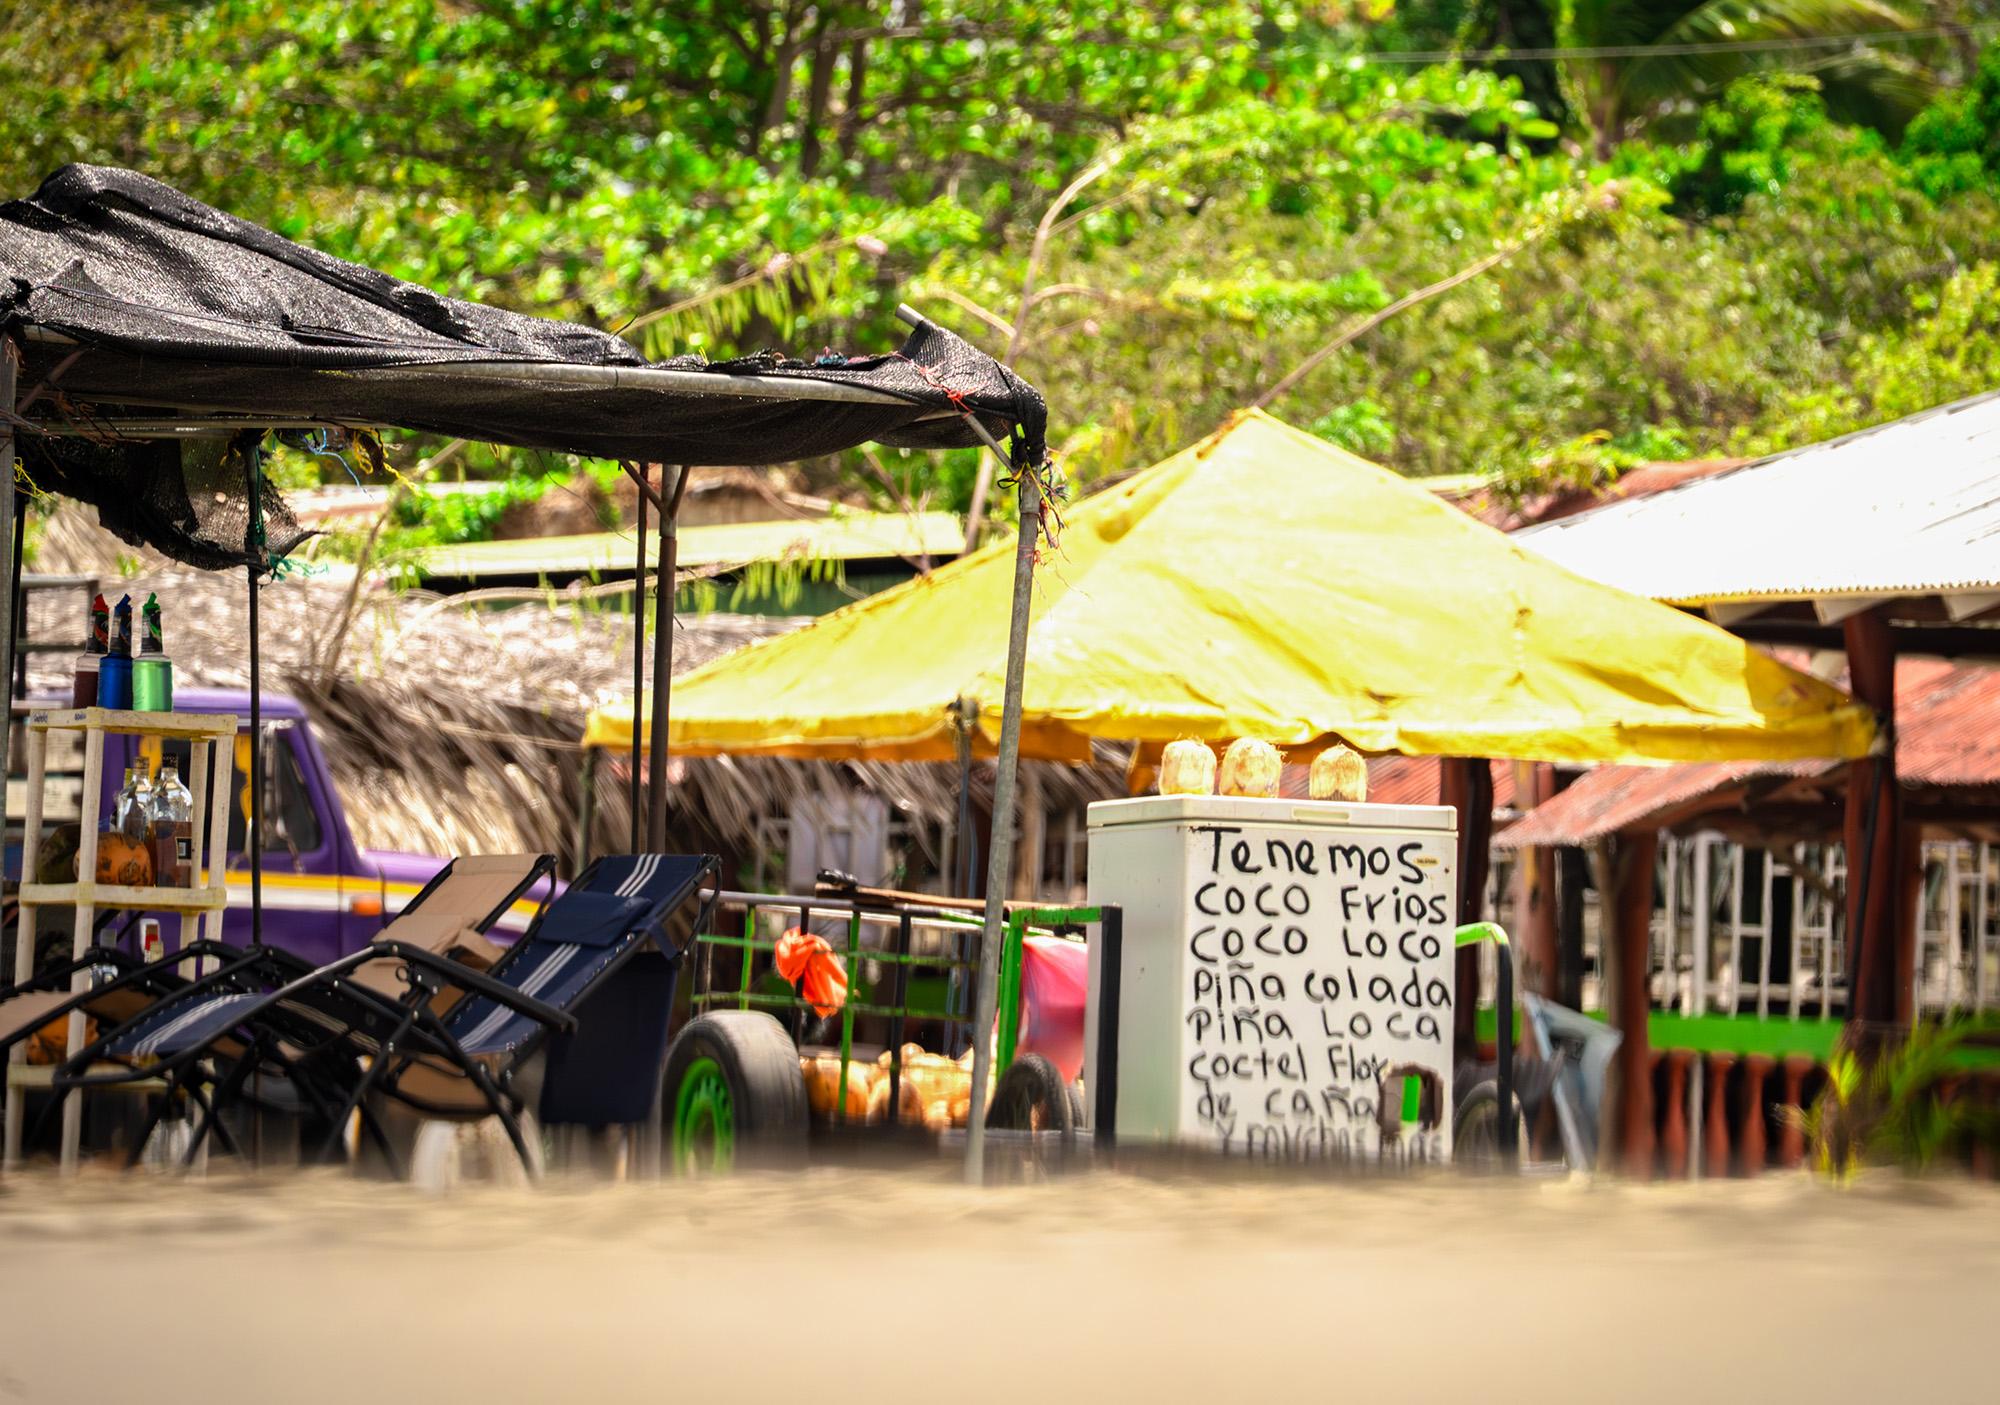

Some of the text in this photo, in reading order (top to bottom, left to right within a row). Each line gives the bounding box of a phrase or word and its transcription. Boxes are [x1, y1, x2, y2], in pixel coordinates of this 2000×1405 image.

[1198, 826, 1424, 884] Tenemos
[1197, 1079, 1376, 1120] de caña
